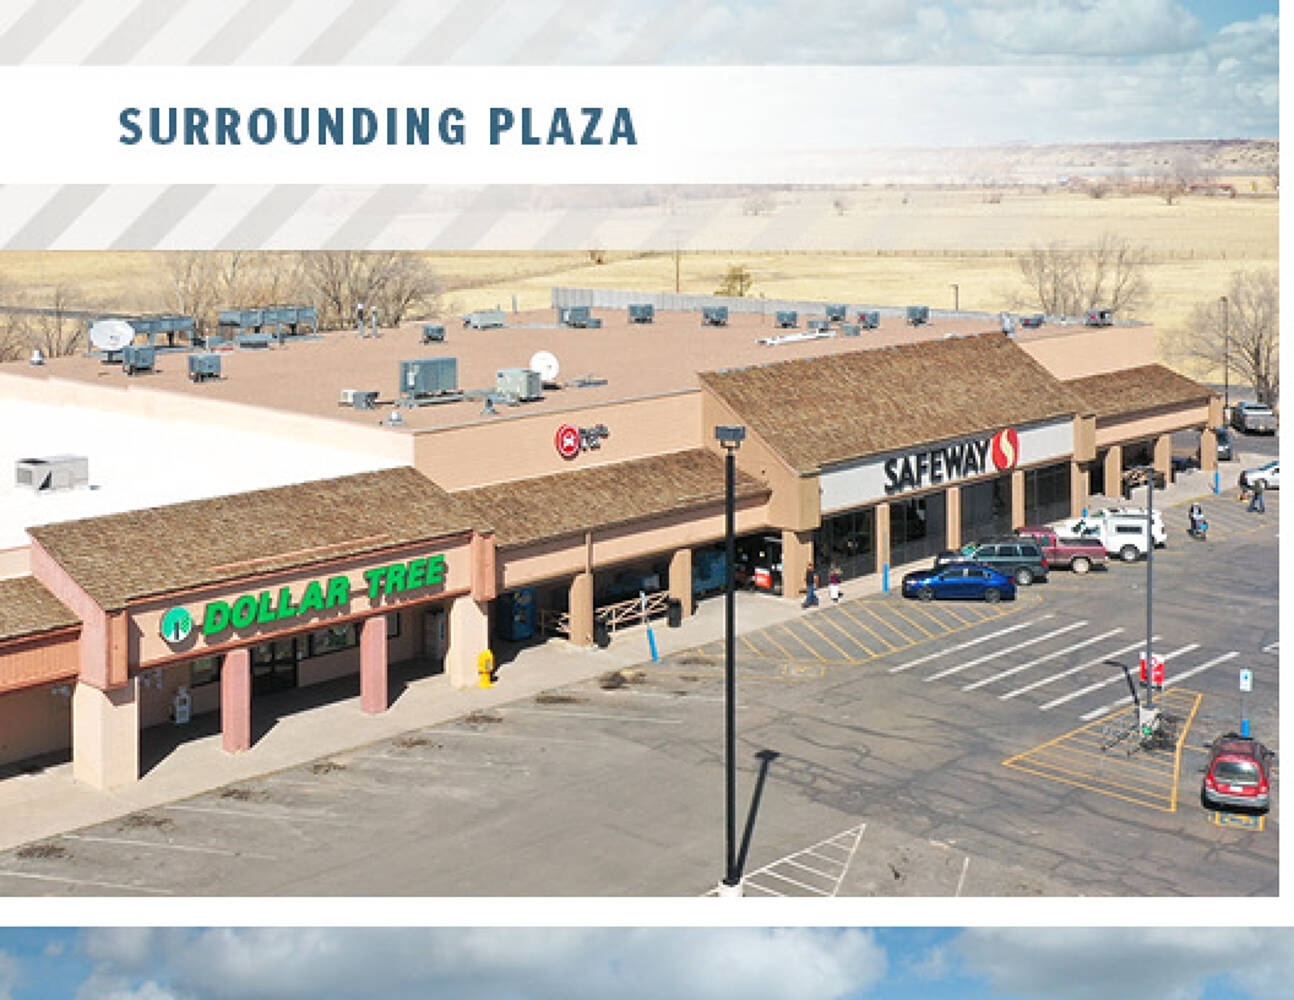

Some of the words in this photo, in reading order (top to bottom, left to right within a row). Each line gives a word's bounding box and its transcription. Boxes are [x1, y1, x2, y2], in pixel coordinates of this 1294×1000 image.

[884, 440, 991, 495] SAFEWAY
[202, 575, 351, 635] DOLLAR
[364, 554, 445, 598] TREE
